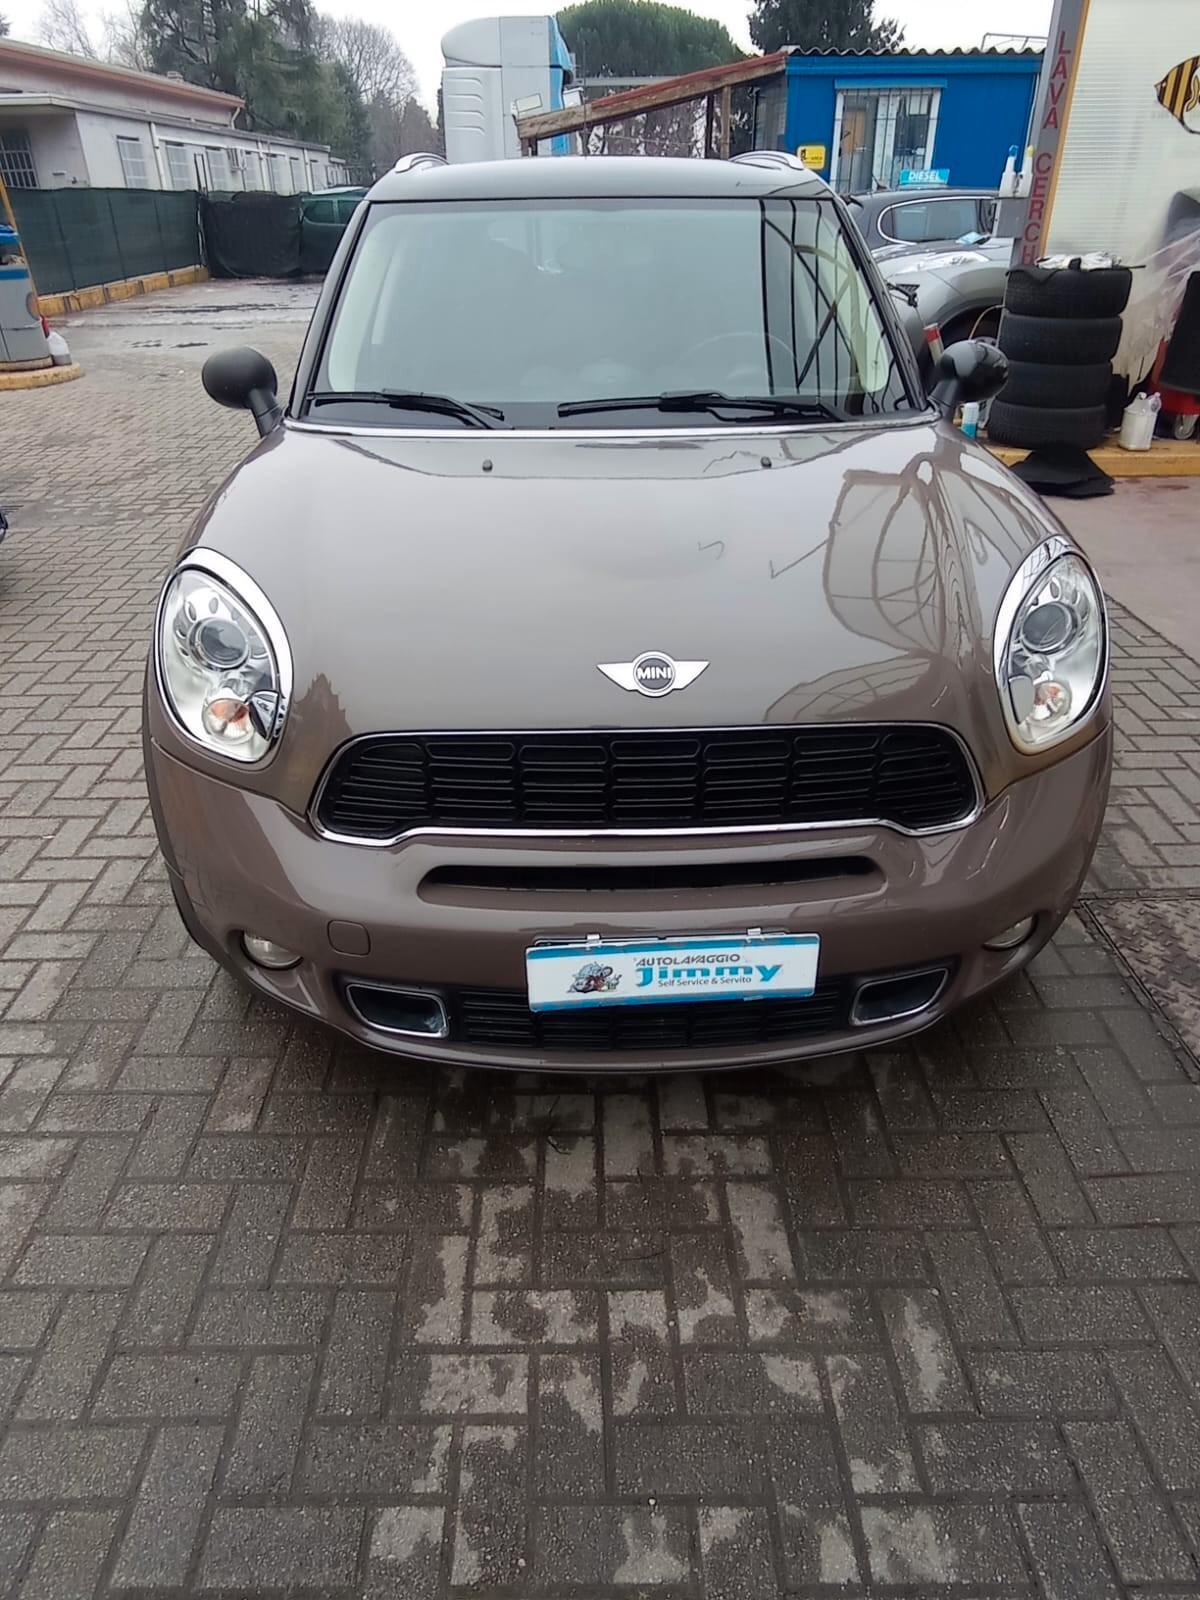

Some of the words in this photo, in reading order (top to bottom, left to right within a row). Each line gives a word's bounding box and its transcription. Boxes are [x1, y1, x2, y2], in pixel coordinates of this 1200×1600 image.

[1043, 31, 1071, 129] LAVA
[908, 171, 941, 182] DIESEL
[637, 667, 672, 680] MINI
[636, 953, 742, 967] AUTOLAVAGGIO
[658, 978, 675, 988] Self
[677, 978, 709, 987] Service
[720, 976, 752, 985] Servito
